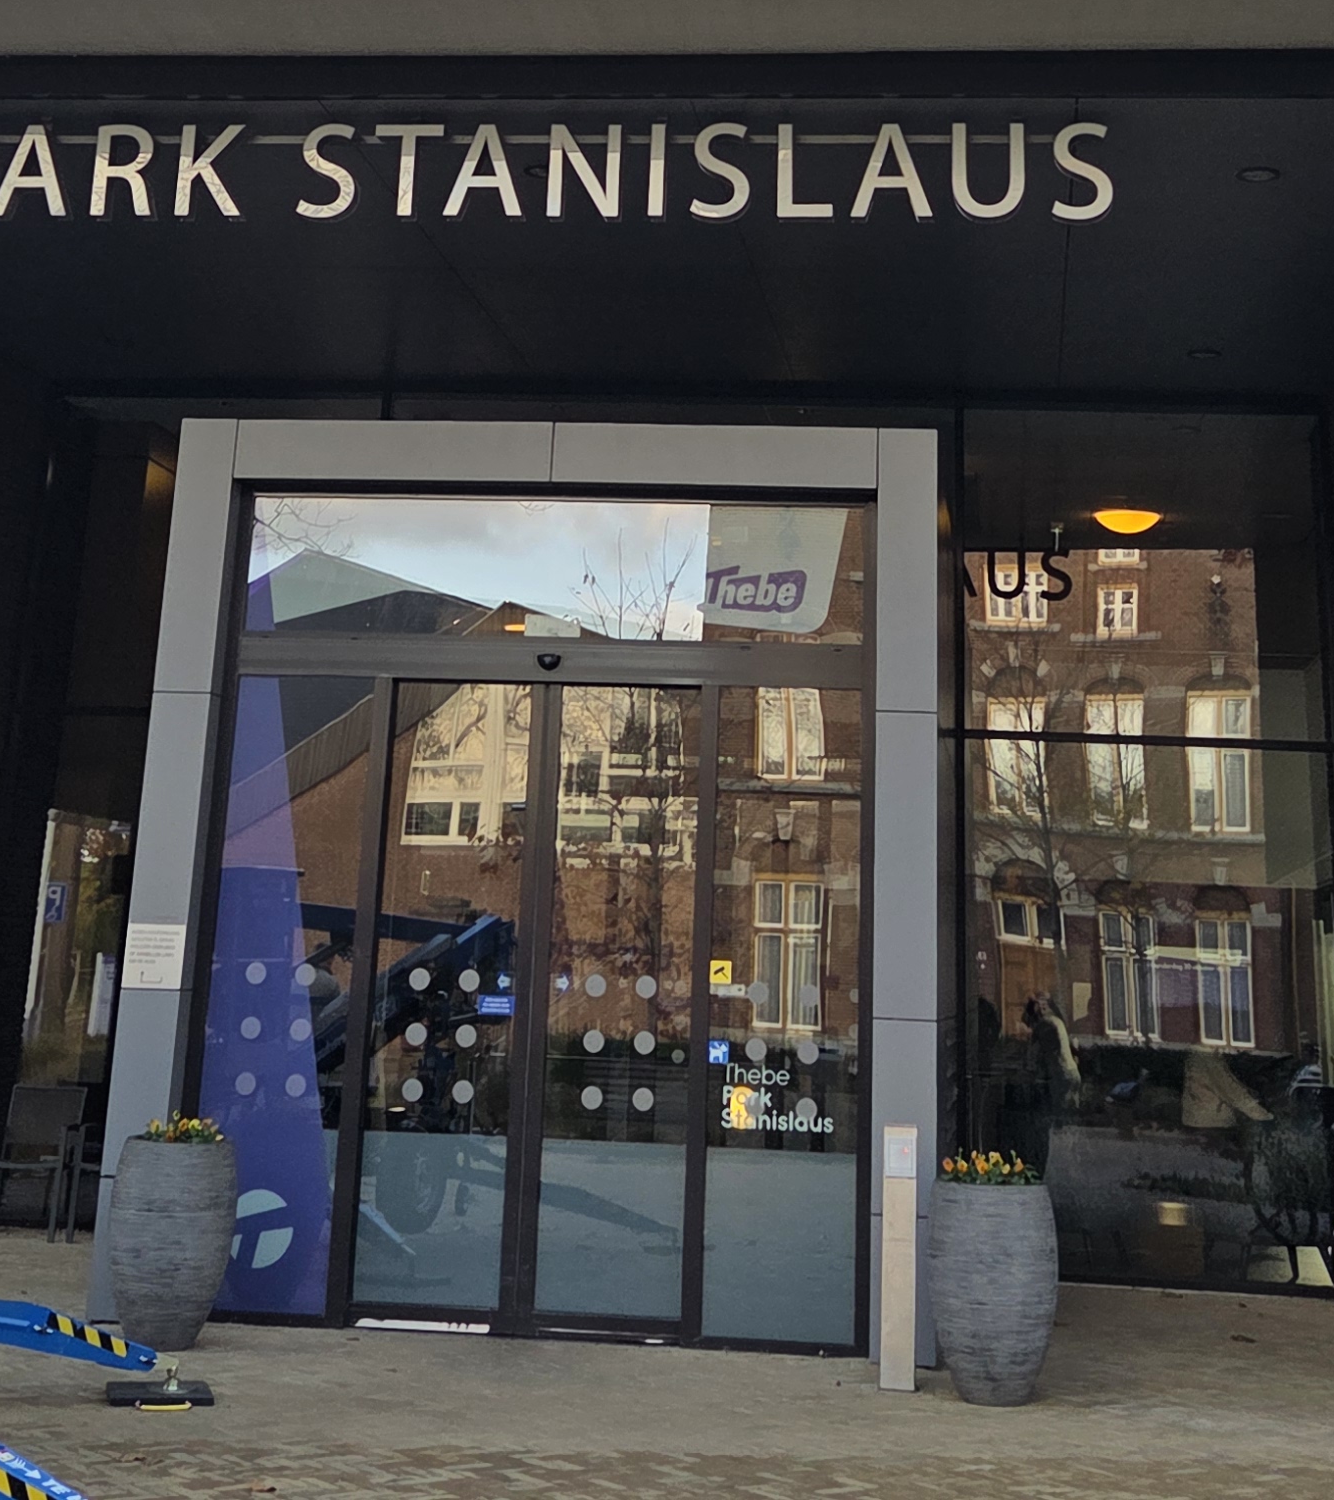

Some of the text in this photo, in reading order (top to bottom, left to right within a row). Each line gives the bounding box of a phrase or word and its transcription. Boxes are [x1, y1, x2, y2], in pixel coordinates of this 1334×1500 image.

[295, 122, 1114, 221] STANISLAUS
[707, 565, 798, 608] Thebe
[726, 1062, 790, 1085] Thebe
[722, 1085, 772, 1108] Park
[720, 1108, 834, 1133] Stanislaus
